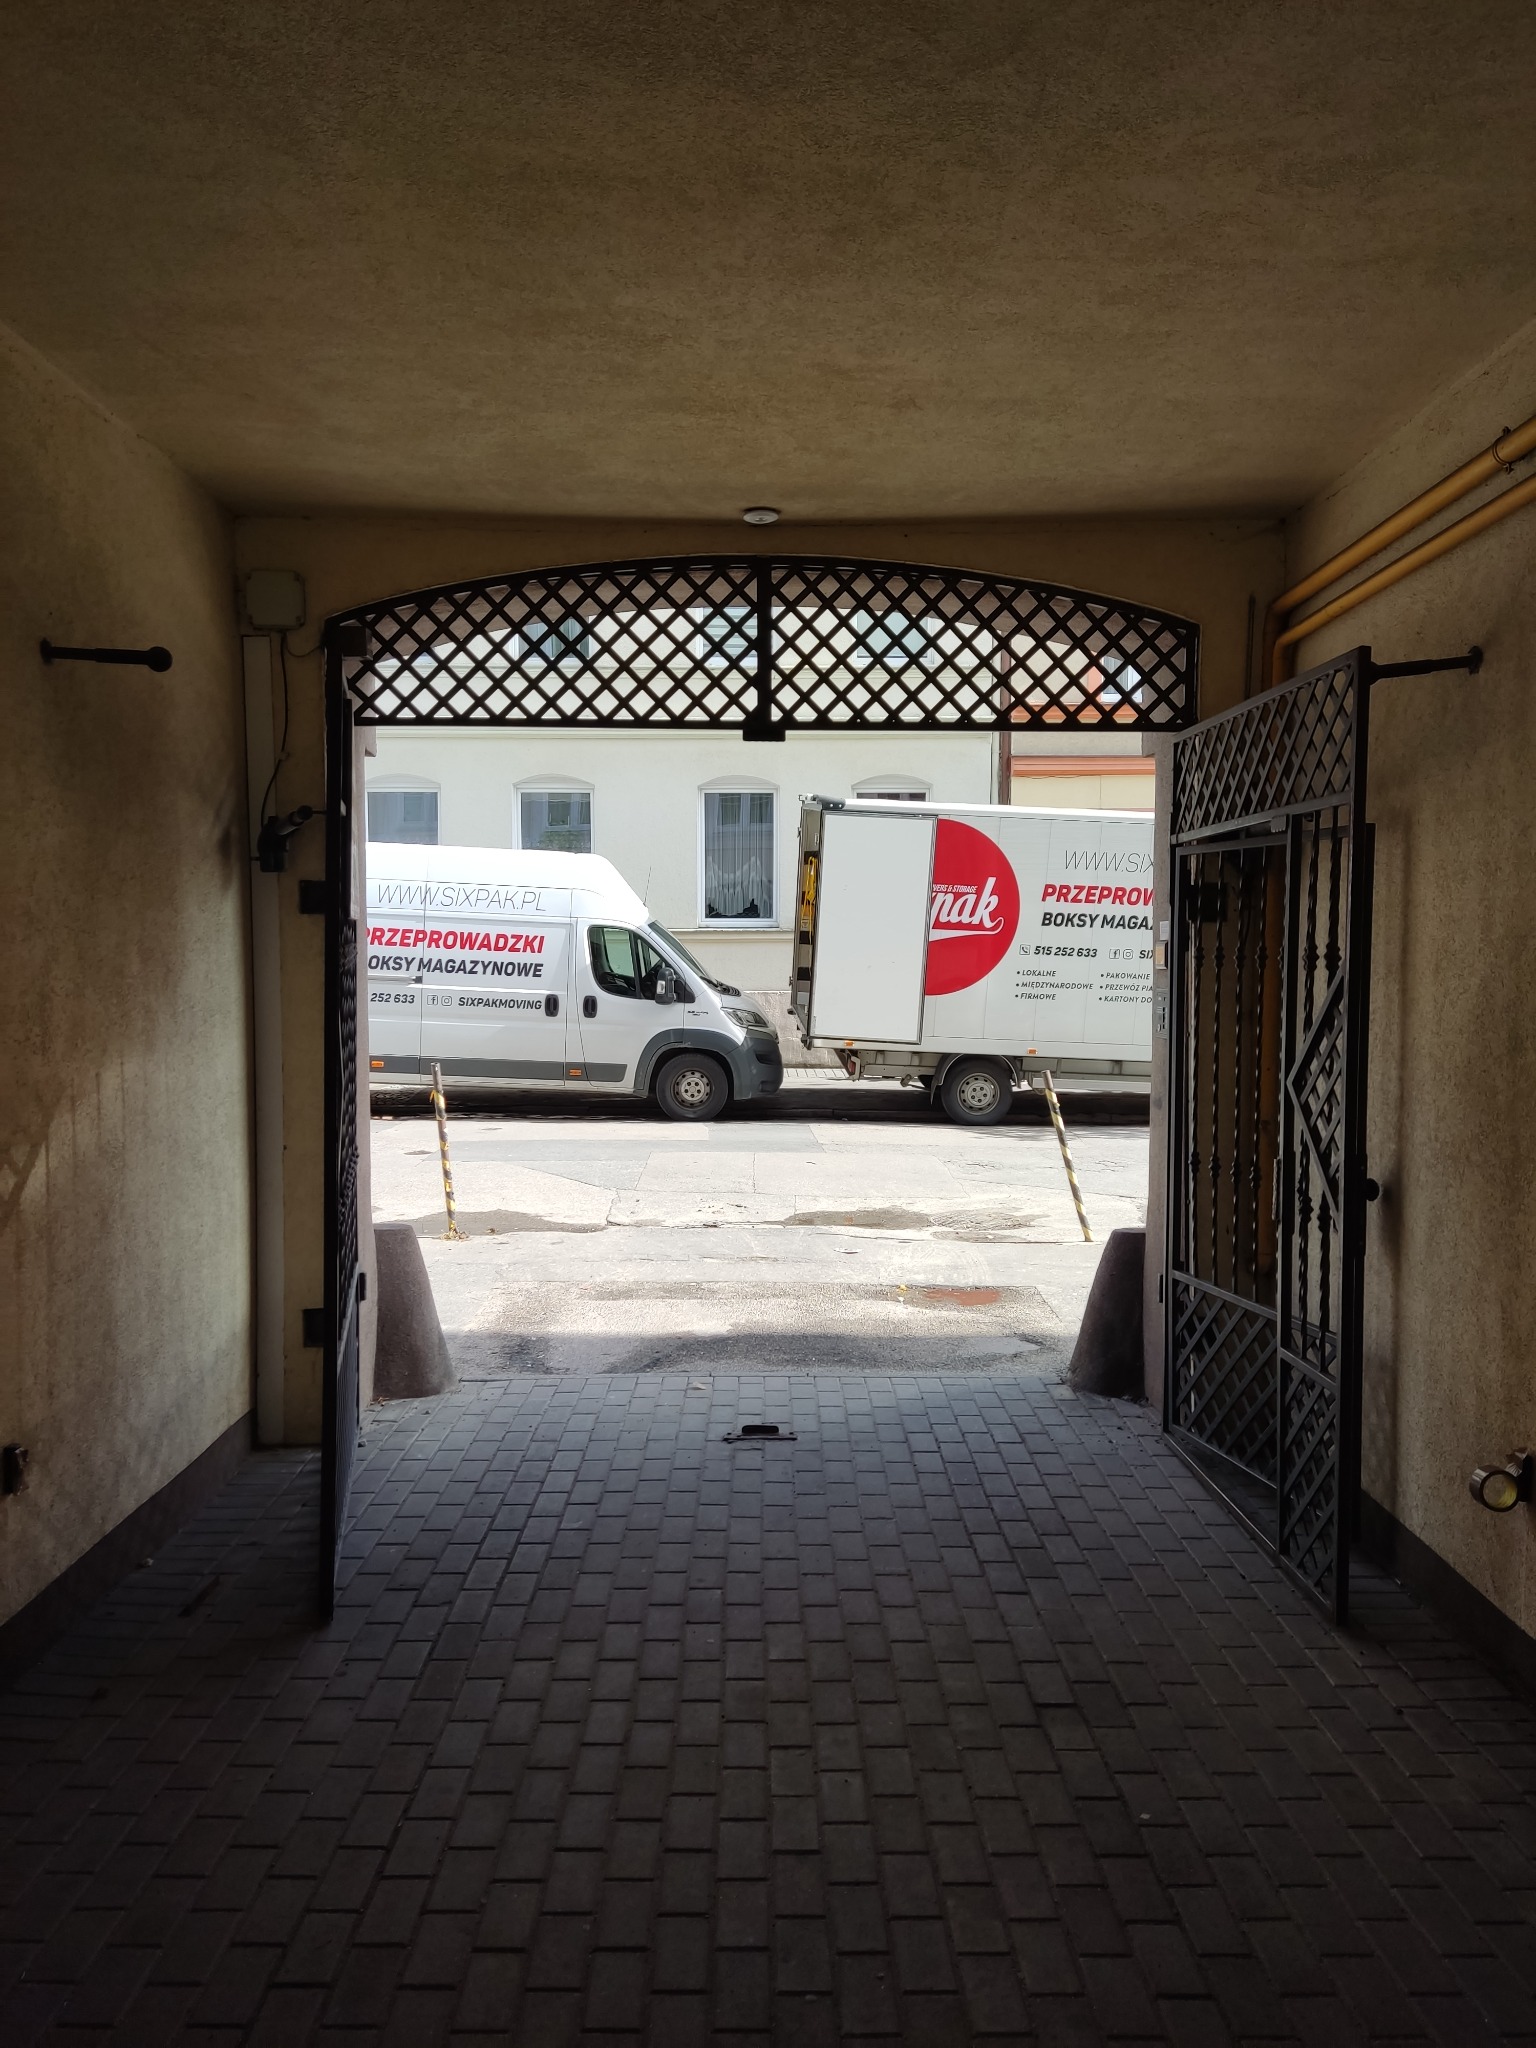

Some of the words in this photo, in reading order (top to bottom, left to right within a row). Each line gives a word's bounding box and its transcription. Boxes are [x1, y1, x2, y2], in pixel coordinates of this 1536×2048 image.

[953, 885, 978, 893] STORAGE
[377, 883, 547, 912] WWW.SIXPAK.PL
[1041, 912, 1100, 929] BOKSY
[1100, 914, 1153, 931] MAGA
[1033, 945, 1053, 956] 515
[1054, 946, 1075, 957] 252
[1076, 947, 1098, 958] 633
[417, 957, 544, 978] MAGAZYNOWE
[1021, 969, 1057, 977] LOKALNE
[1105, 972, 1151, 980] PAKOWANIE
[1020, 981, 1094, 990] MIĘDZYNARODOWE
[370, 992, 392, 1003] 252
[393, 993, 416, 1004] 633
[1020, 992, 1057, 1000] FIRMOWE
[1103, 995, 1140, 1003] KARTONY
[457, 996, 543, 1010] SIXPAKMOVING
